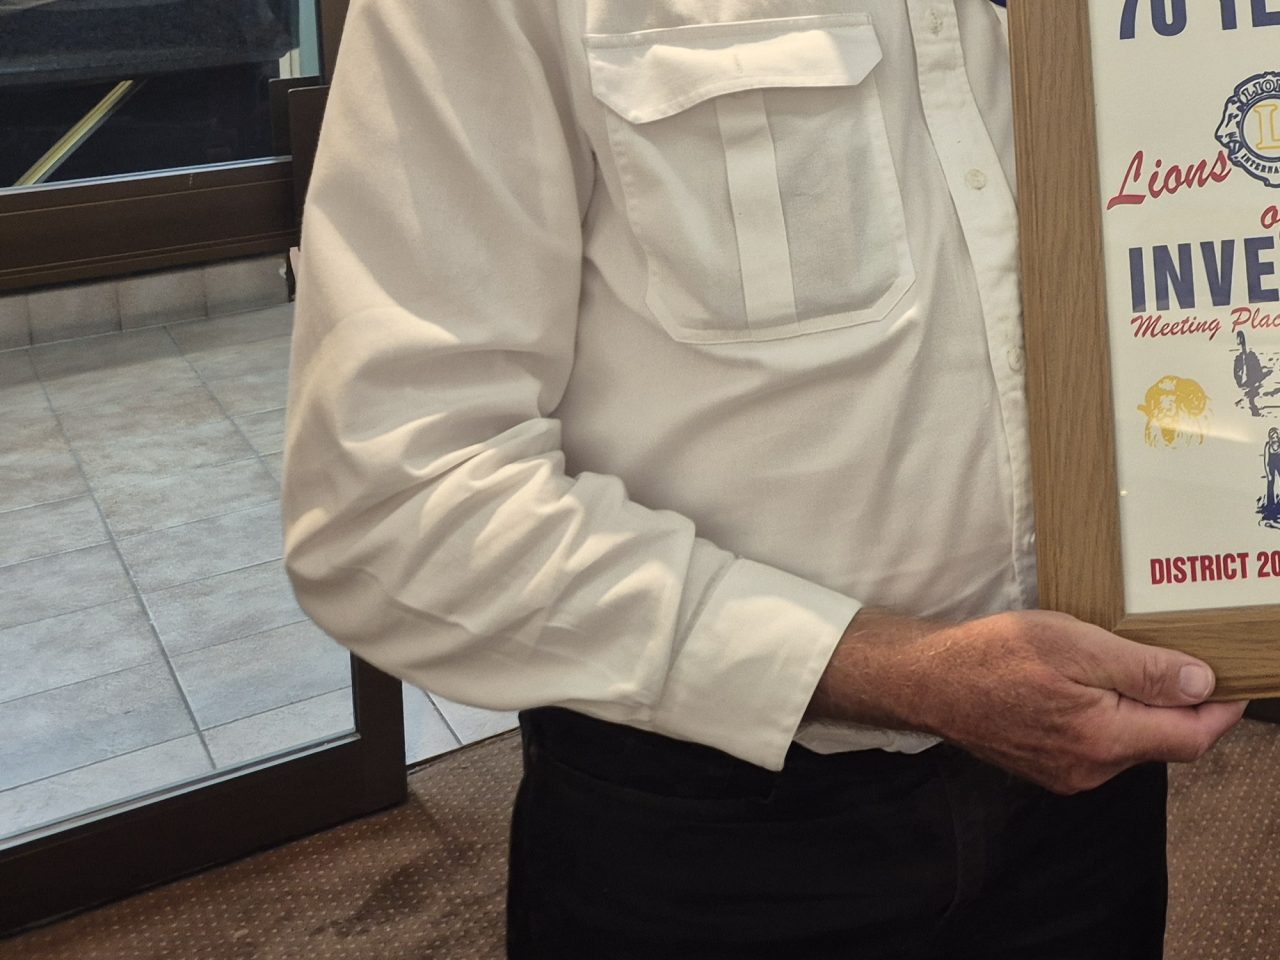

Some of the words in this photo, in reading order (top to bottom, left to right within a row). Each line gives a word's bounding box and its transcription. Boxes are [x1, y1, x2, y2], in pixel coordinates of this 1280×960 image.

[1106, 150, 1233, 211] Lions
[1130, 307, 1222, 341] Meeting
[1150, 552, 1249, 585] DISTRICT
